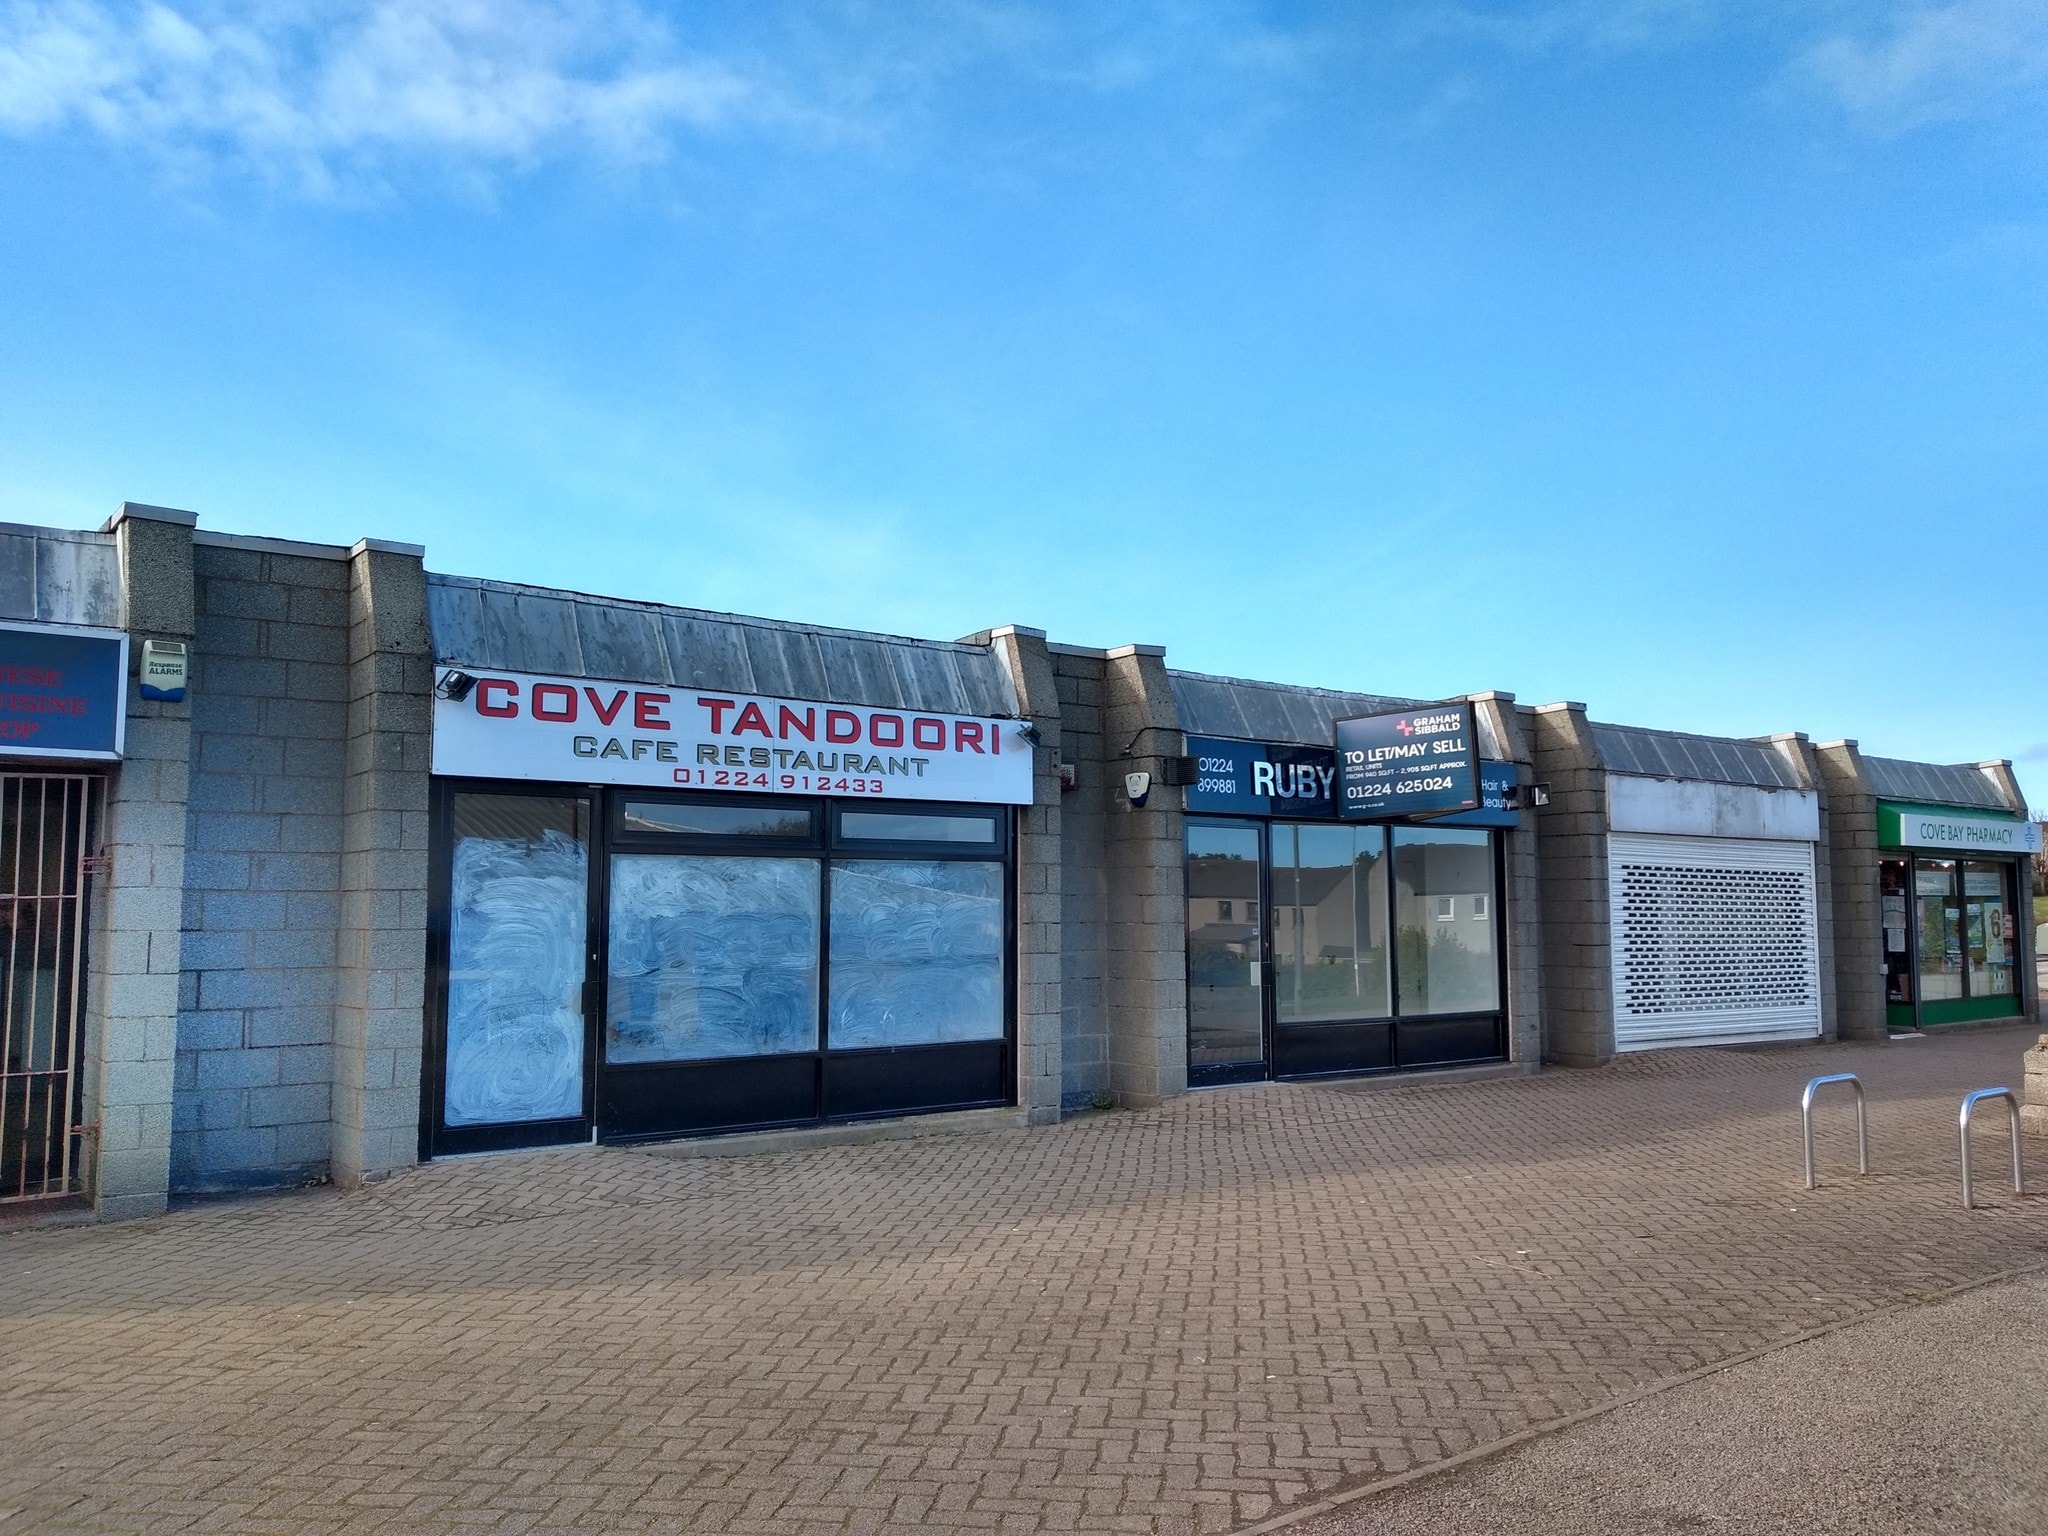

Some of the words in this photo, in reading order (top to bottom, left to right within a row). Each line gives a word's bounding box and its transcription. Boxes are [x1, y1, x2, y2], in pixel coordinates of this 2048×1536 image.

[149, 667, 183, 676] ALARMS
[476, 678, 671, 731] COVE
[697, 696, 1000, 755] TANDOORI
[1413, 713, 1460, 727] GRAHAM
[1414, 722, 1461, 736] SIBBALD
[573, 735, 679, 763] CAFE
[696, 743, 930, 777] RESTAURANT
[1344, 751, 1365, 764] TO
[1368, 742, 1428, 762] LET/MAY
[1433, 738, 1467, 754] SELL
[1345, 765, 1365, 773] RETAIL
[1366, 763, 1383, 771] UNITS
[1346, 772, 1364, 780] FROM
[1365, 770, 1378, 778] 940
[673, 768, 769, 787] 01224
[780, 774, 883, 794] 912433
[1197, 778, 1236, 794] 899881
[1198, 757, 1234, 773] 01224
[1253, 760, 1336, 799] RUBY
[1347, 782, 1392, 799] 01224
[1396, 776, 1453, 794] 625024
[1481, 779, 1498, 791] Hair
[1501, 780, 1510, 791] &
[1920, 822, 1946, 840] COVE
[1948, 825, 1964, 842] BAY
[1966, 827, 2013, 845] PHARMACY
